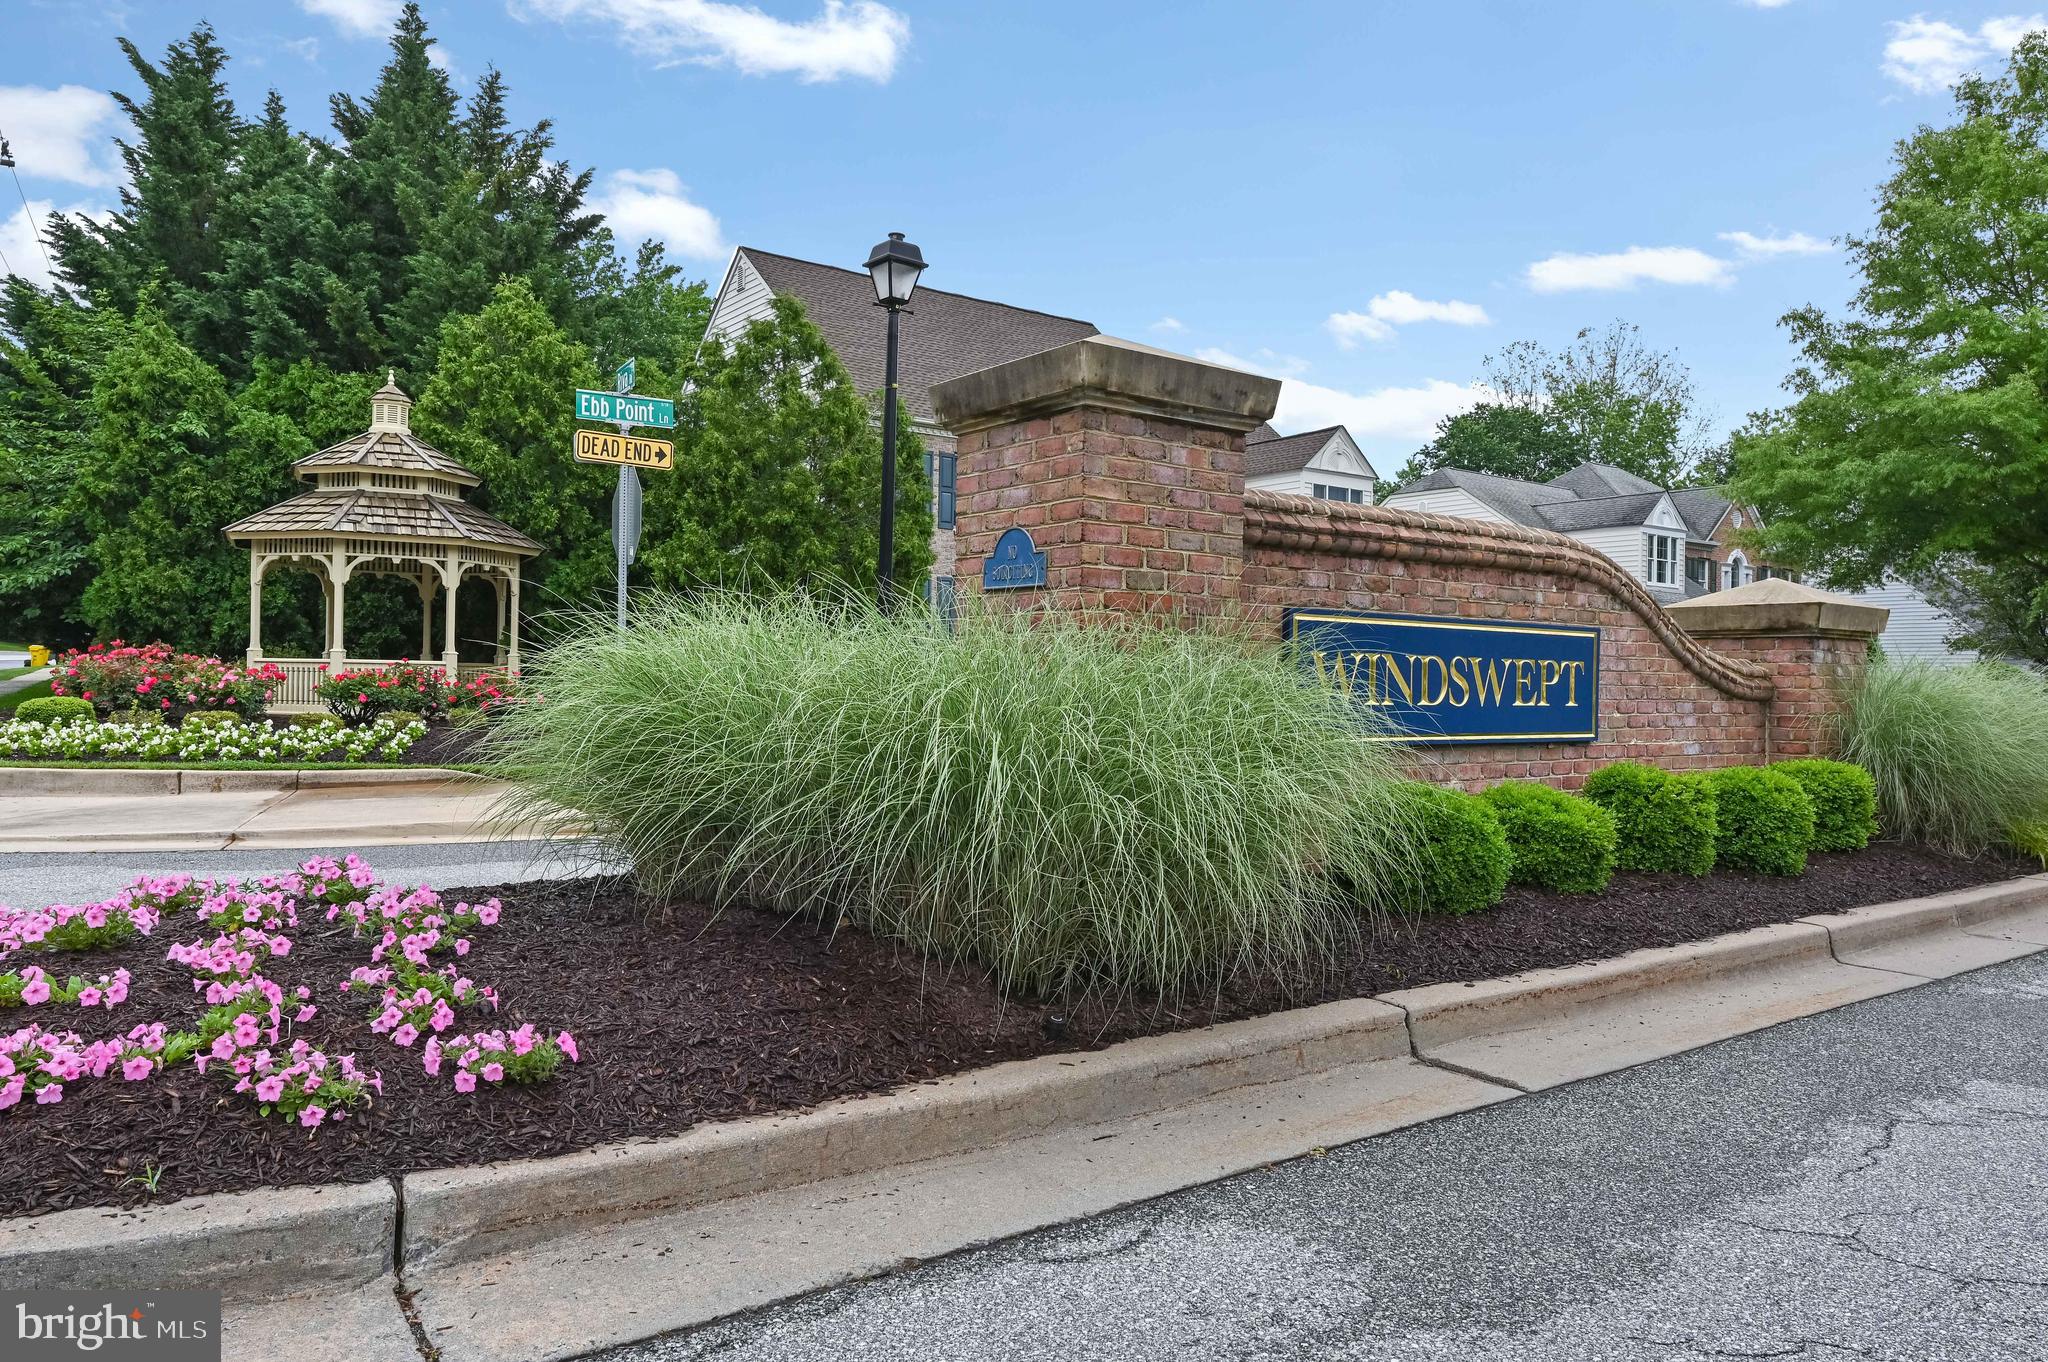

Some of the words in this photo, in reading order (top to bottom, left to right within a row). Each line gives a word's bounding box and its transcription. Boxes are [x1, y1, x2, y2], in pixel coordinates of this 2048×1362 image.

[581, 395, 609, 417] Ebb
[616, 399, 654, 422] Point
[659, 413, 669, 423] Ln
[582, 435, 620, 458] DEAD
[625, 441, 652, 462] END
[1007, 545, 1018, 560] NO
[1311, 650, 1585, 707] WINDSWEPT
